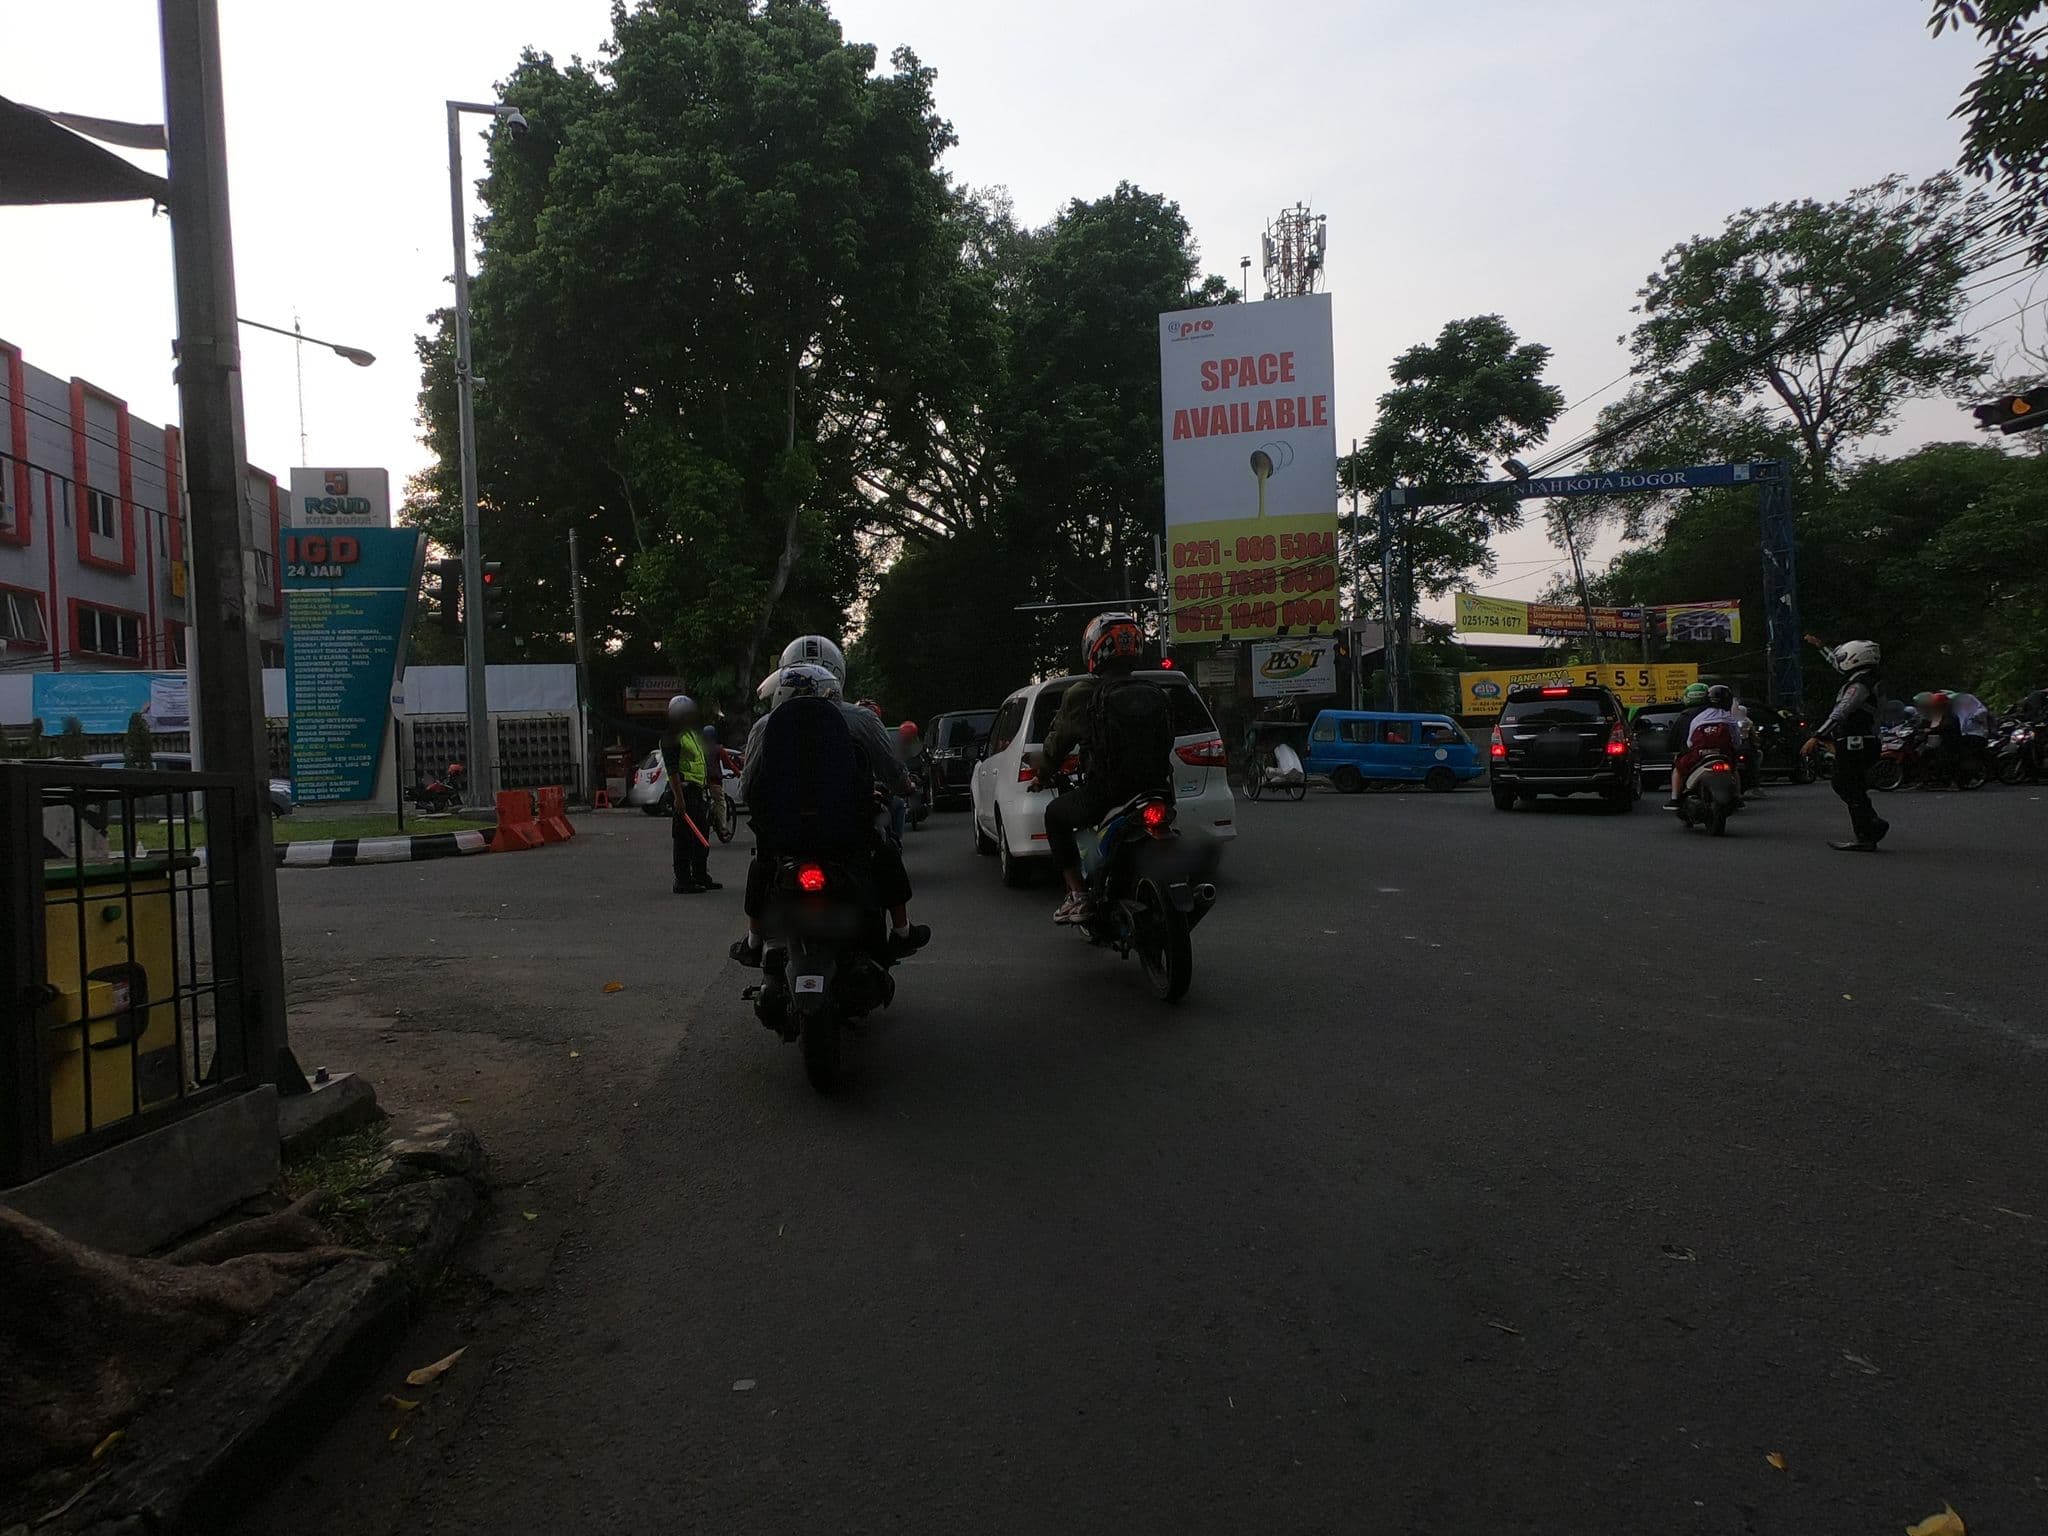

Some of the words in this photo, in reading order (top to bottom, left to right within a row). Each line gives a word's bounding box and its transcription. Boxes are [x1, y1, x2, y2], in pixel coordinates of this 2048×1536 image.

[1200, 351, 1296, 392] SPACE
[1172, 395, 1328, 441] AVAILABLE
[1567, 476, 1613, 492] KOTA
[1620, 472, 1687, 488] BOGOR
[304, 496, 371, 515] RSUD
[286, 535, 360, 563] IGD
[1173, 539, 1220, 569] 0251
[287, 566, 306, 578] 24
[310, 566, 343, 578] JAM
[1585, 670, 1598, 686] 5
[1614, 670, 1626, 687] 5
[1638, 670, 1649, 687] 5
